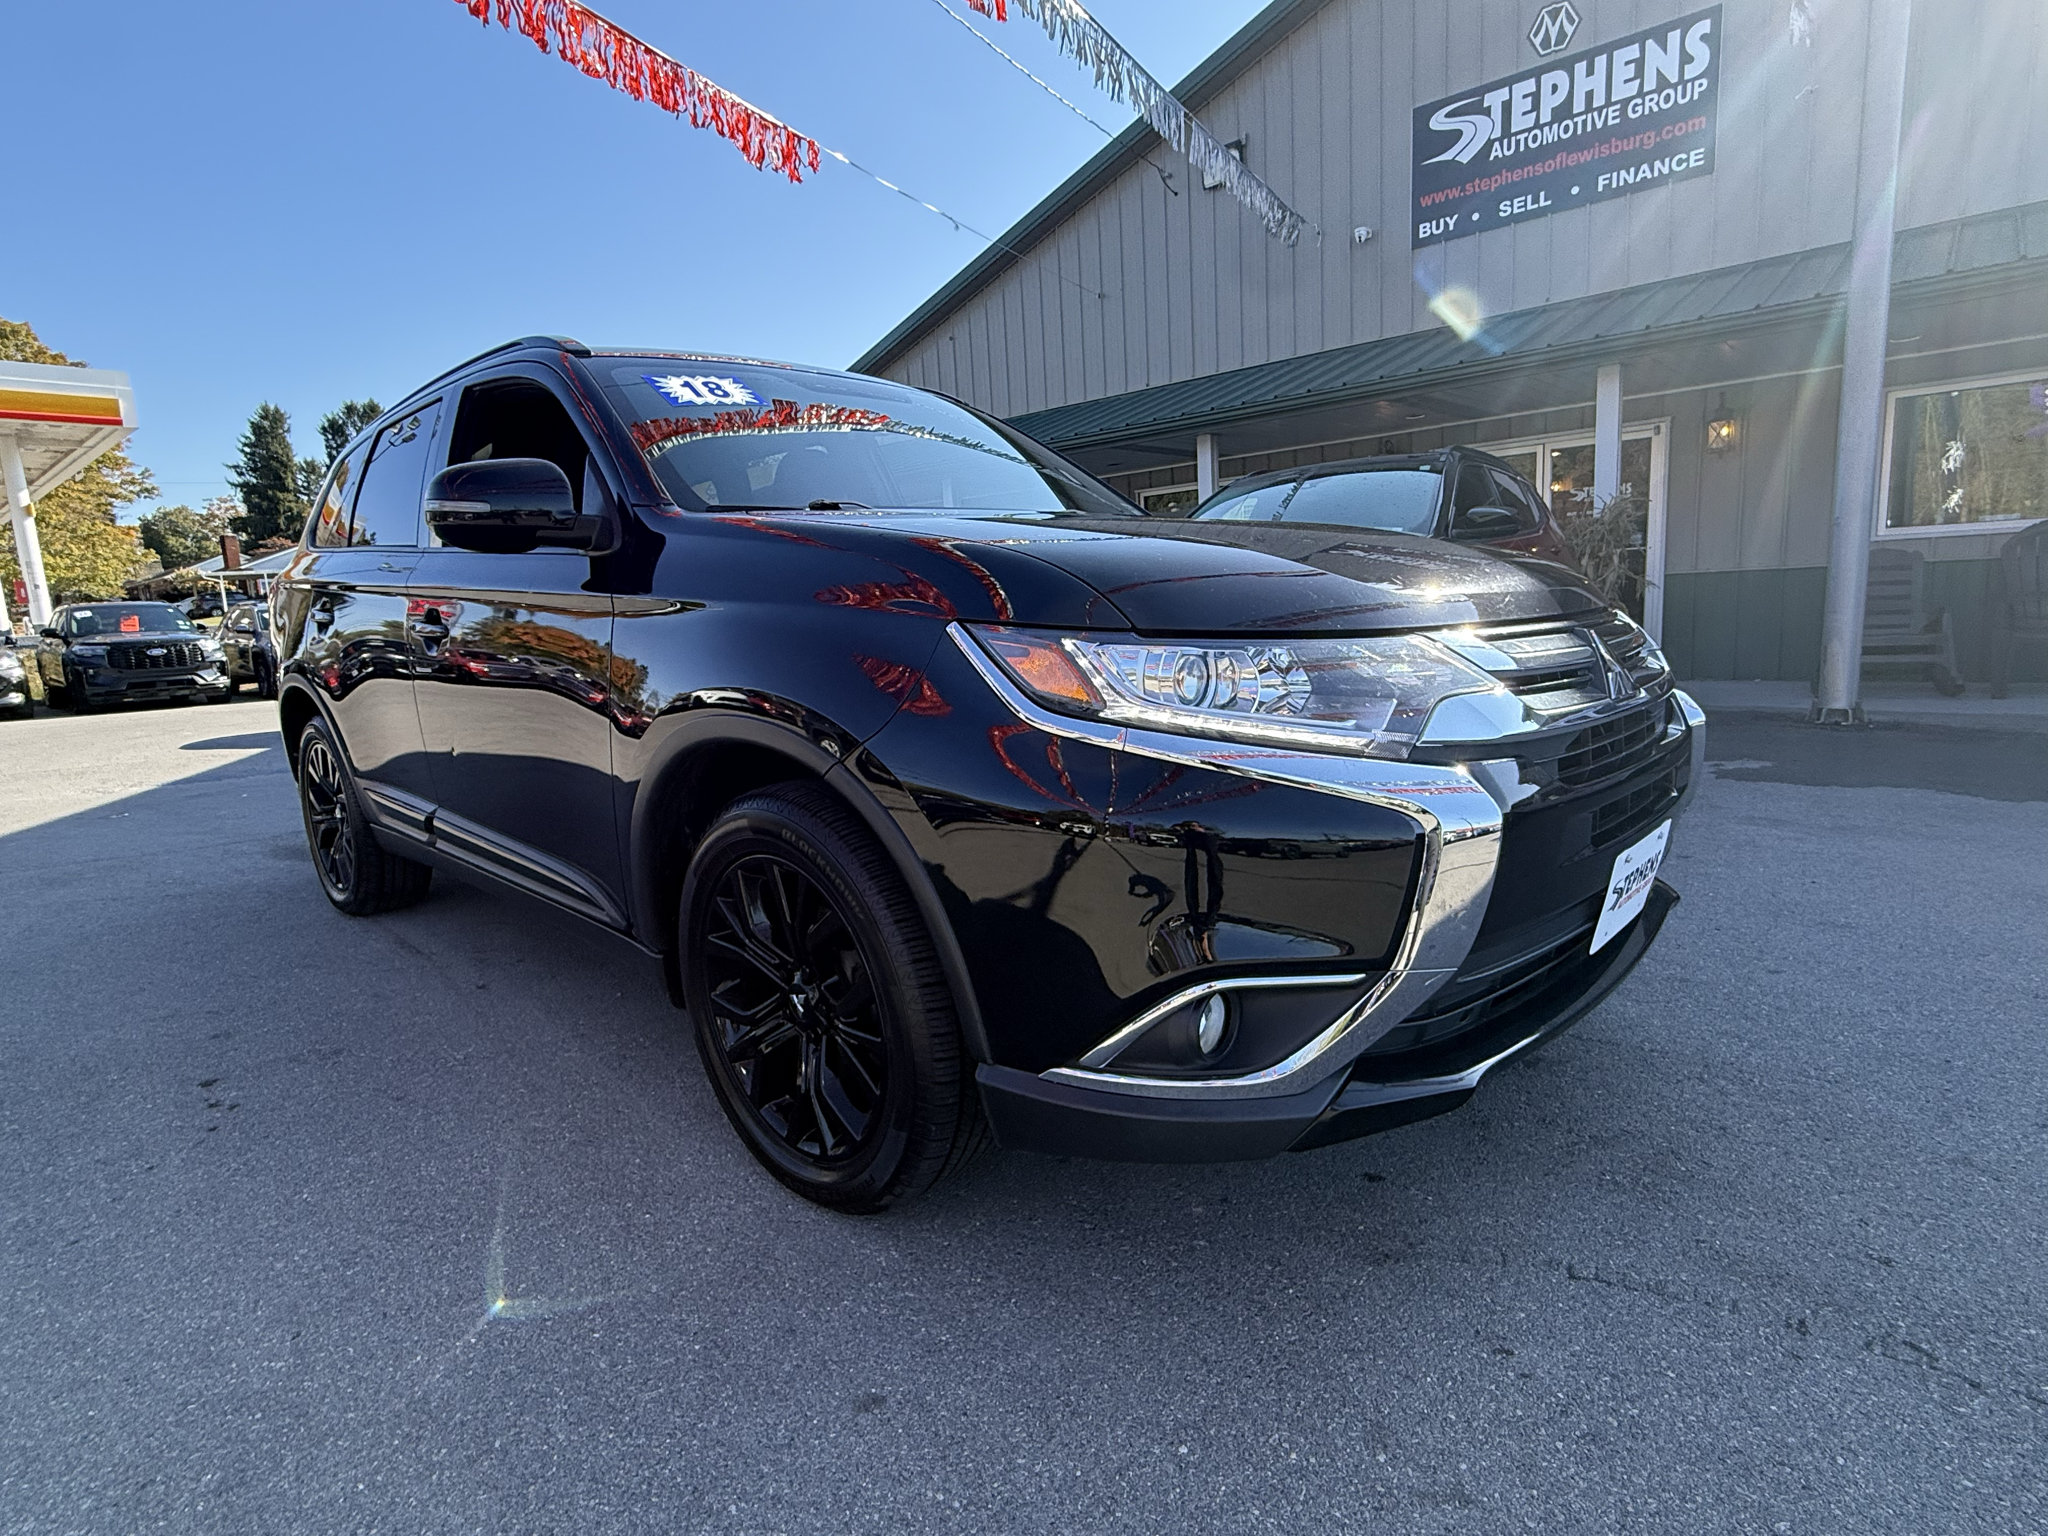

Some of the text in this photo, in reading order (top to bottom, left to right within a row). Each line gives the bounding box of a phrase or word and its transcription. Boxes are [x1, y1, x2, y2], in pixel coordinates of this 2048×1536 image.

[1421, 19, 1711, 165] STEPHENS
[1489, 78, 1708, 161] AUTOMOTIVE GROUP
[1418, 148, 1706, 239] BUY SELL FINANCE
[1419, 115, 1706, 208] www.stephensoflewisburg.com
[680, 380, 731, 398] 18
[1569, 482, 1632, 502] STENS
